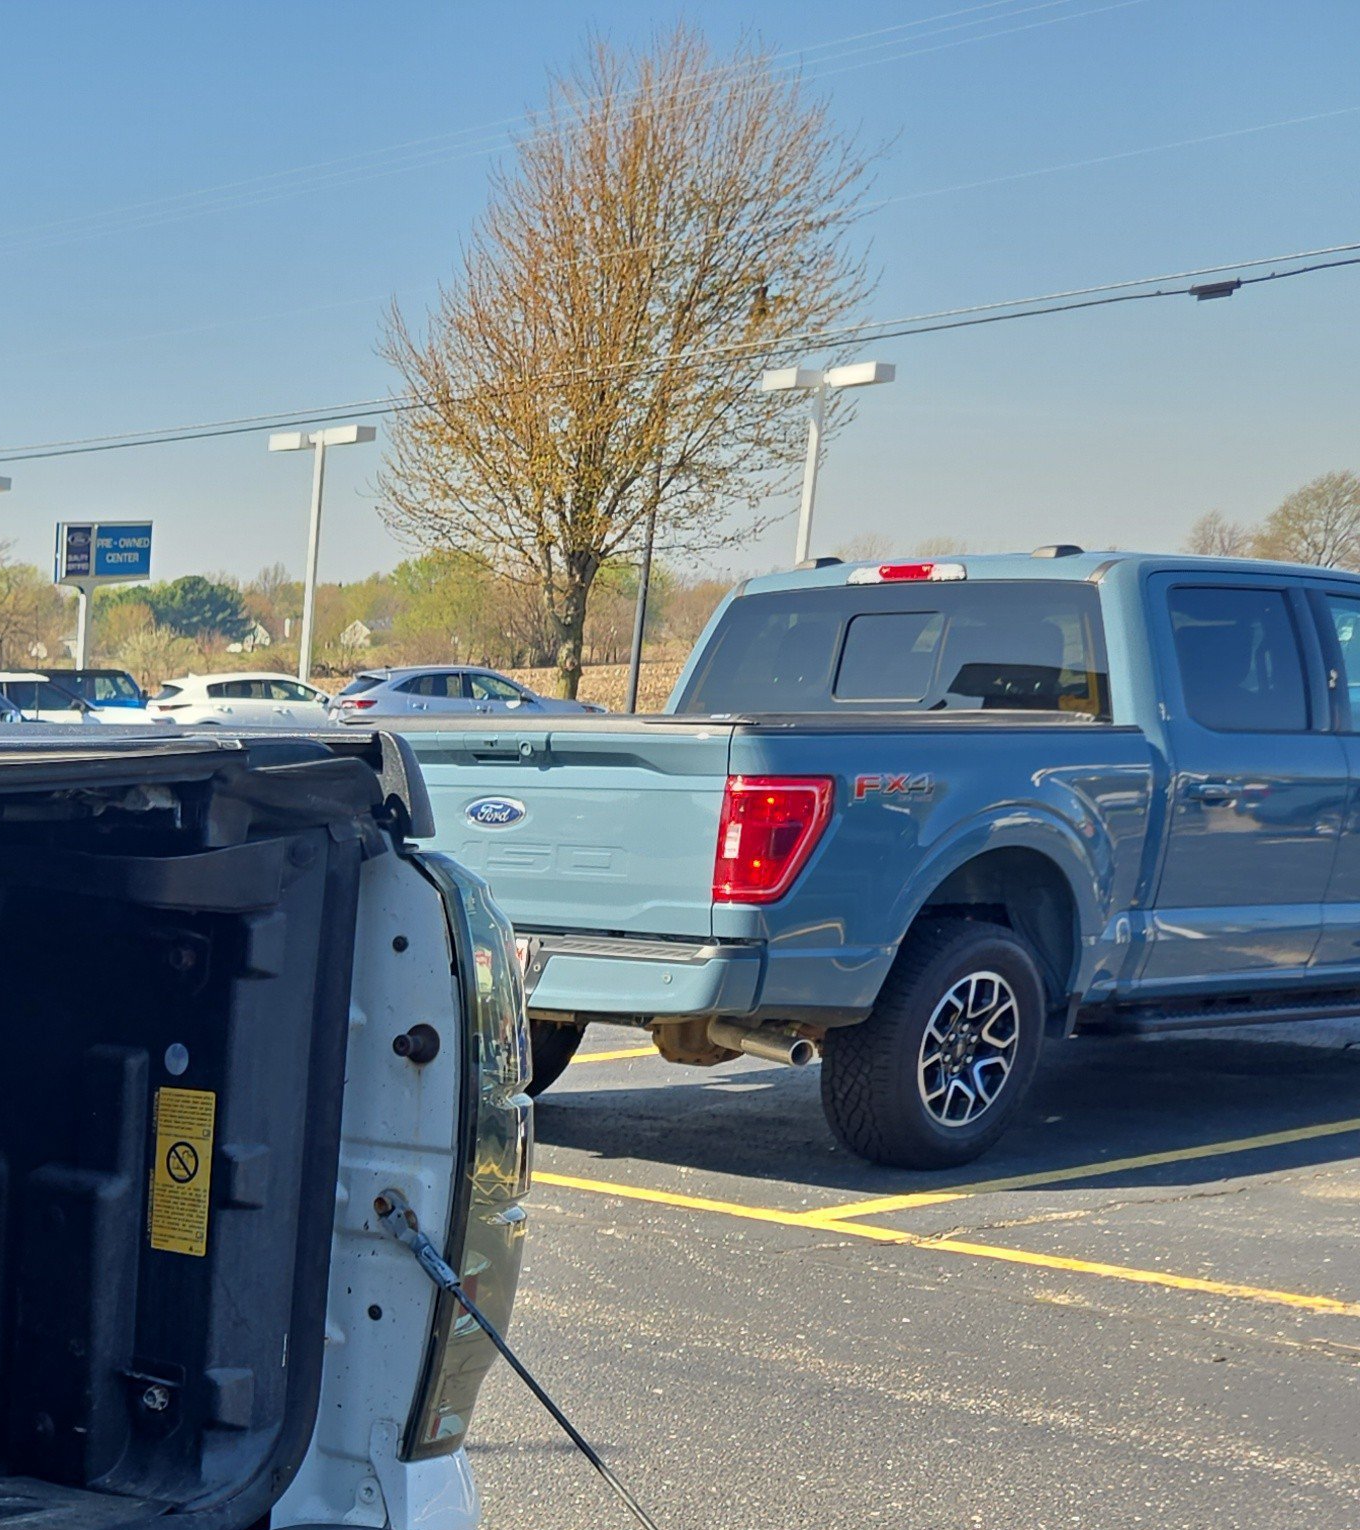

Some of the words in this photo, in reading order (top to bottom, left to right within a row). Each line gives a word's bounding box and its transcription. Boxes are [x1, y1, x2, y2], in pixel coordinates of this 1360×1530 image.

[105, 552, 140, 564] CENTER
[854, 773, 934, 799] FX4
[477, 804, 510, 824] Ford
